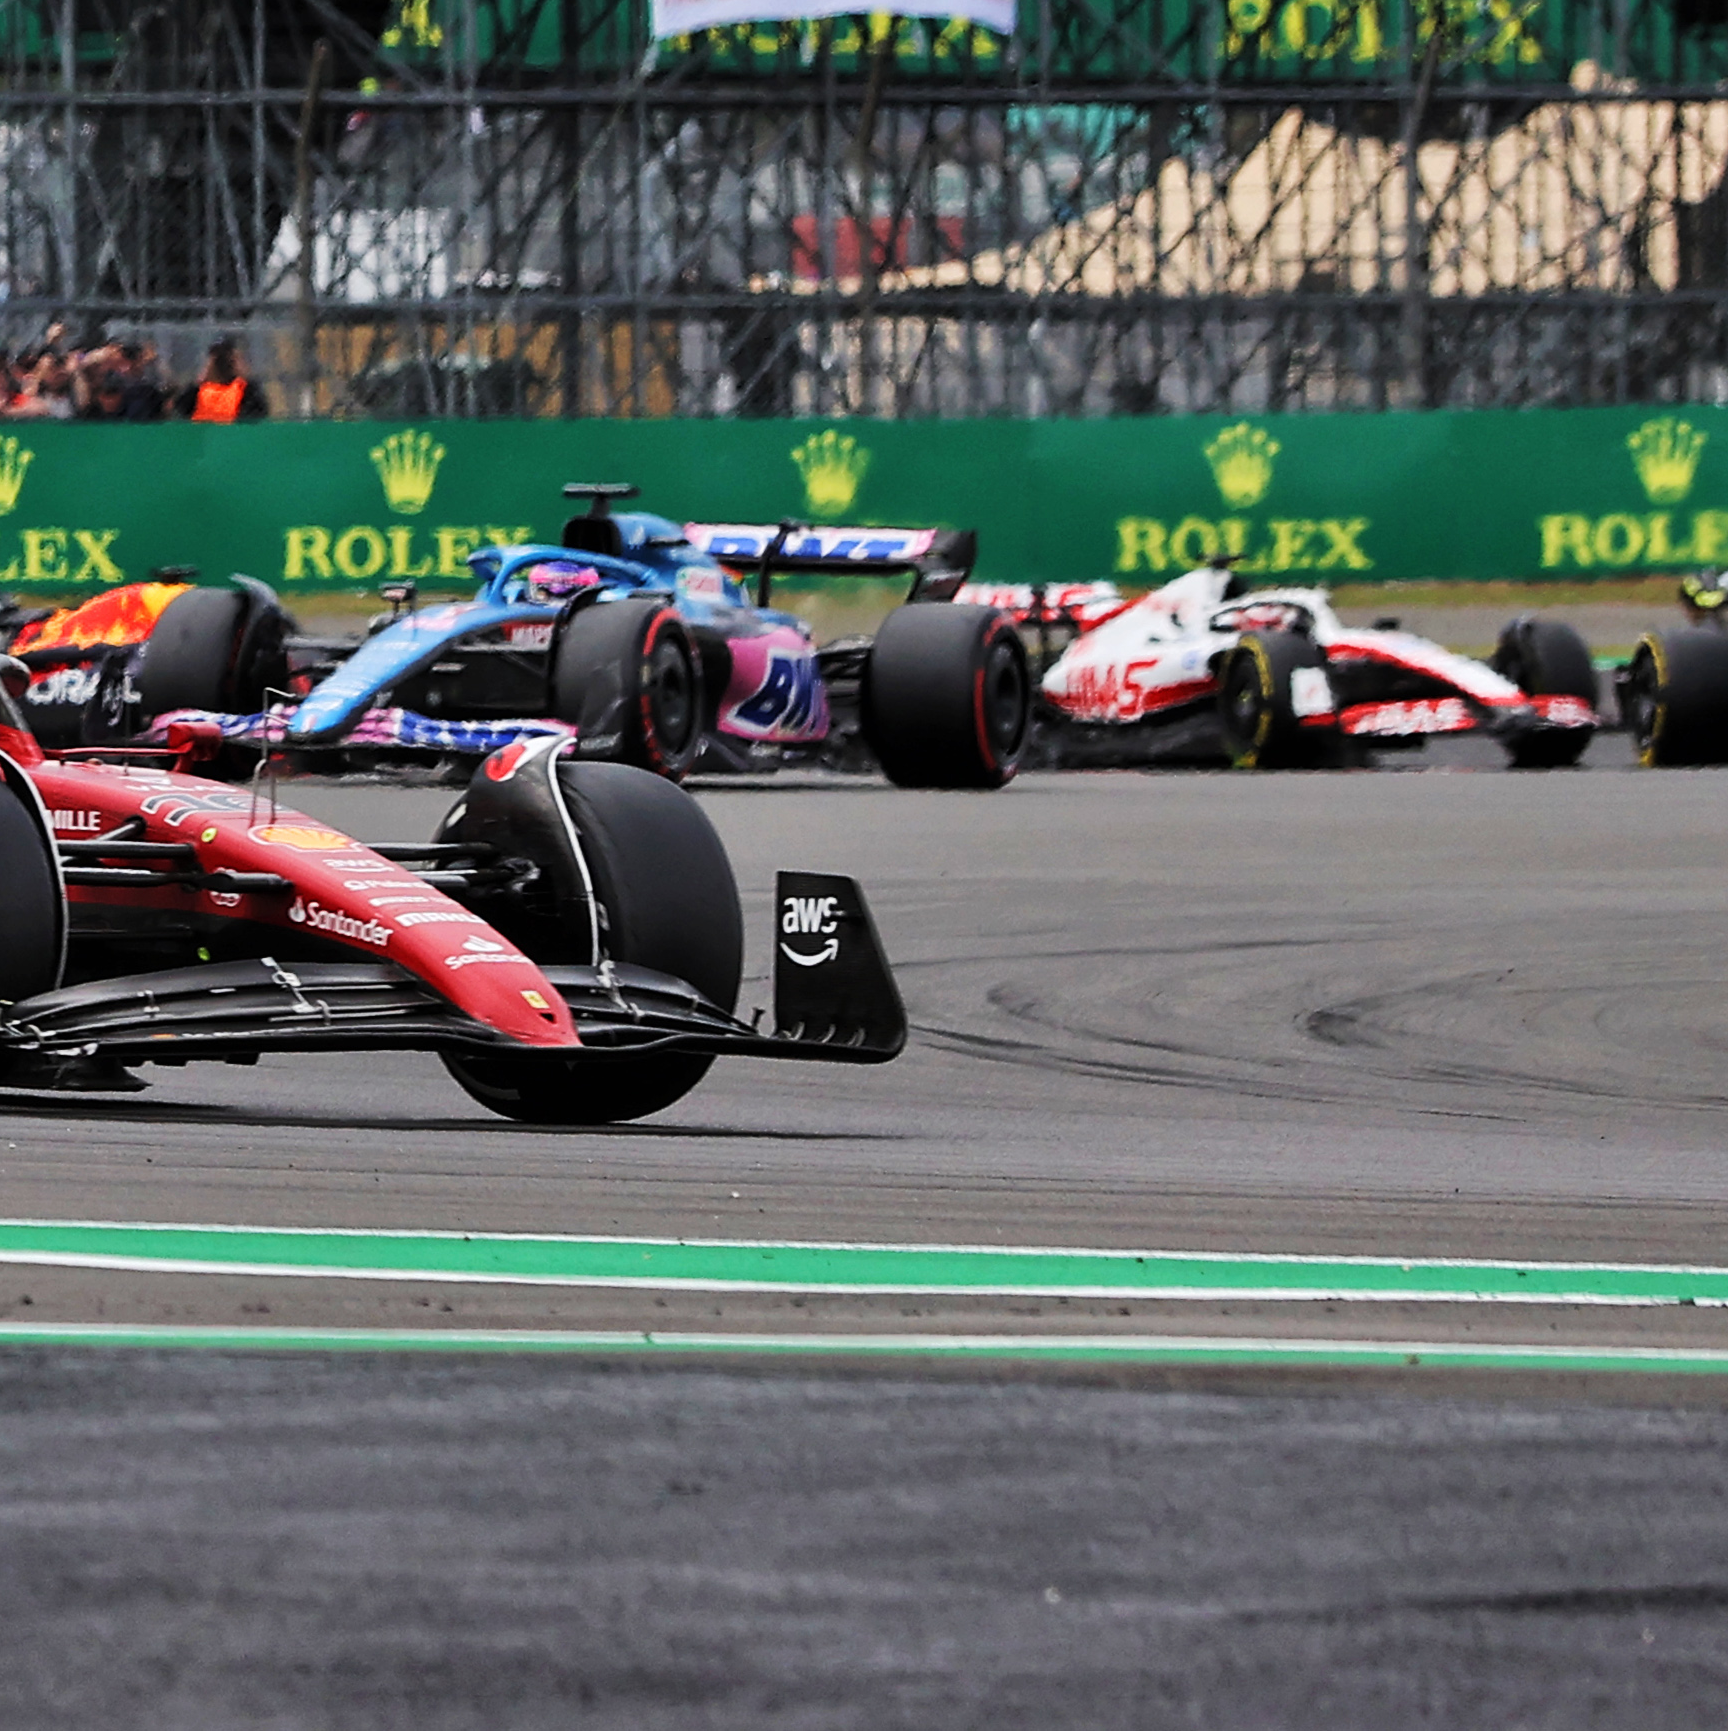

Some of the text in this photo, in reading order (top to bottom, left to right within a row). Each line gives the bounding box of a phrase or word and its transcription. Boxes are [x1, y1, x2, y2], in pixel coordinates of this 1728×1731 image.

[1116, 515, 1373, 572] ROLEX
[1538, 510, 1728, 569] ROLE
[306, 901, 394, 947] Santander
[782, 896, 839, 935] aws
